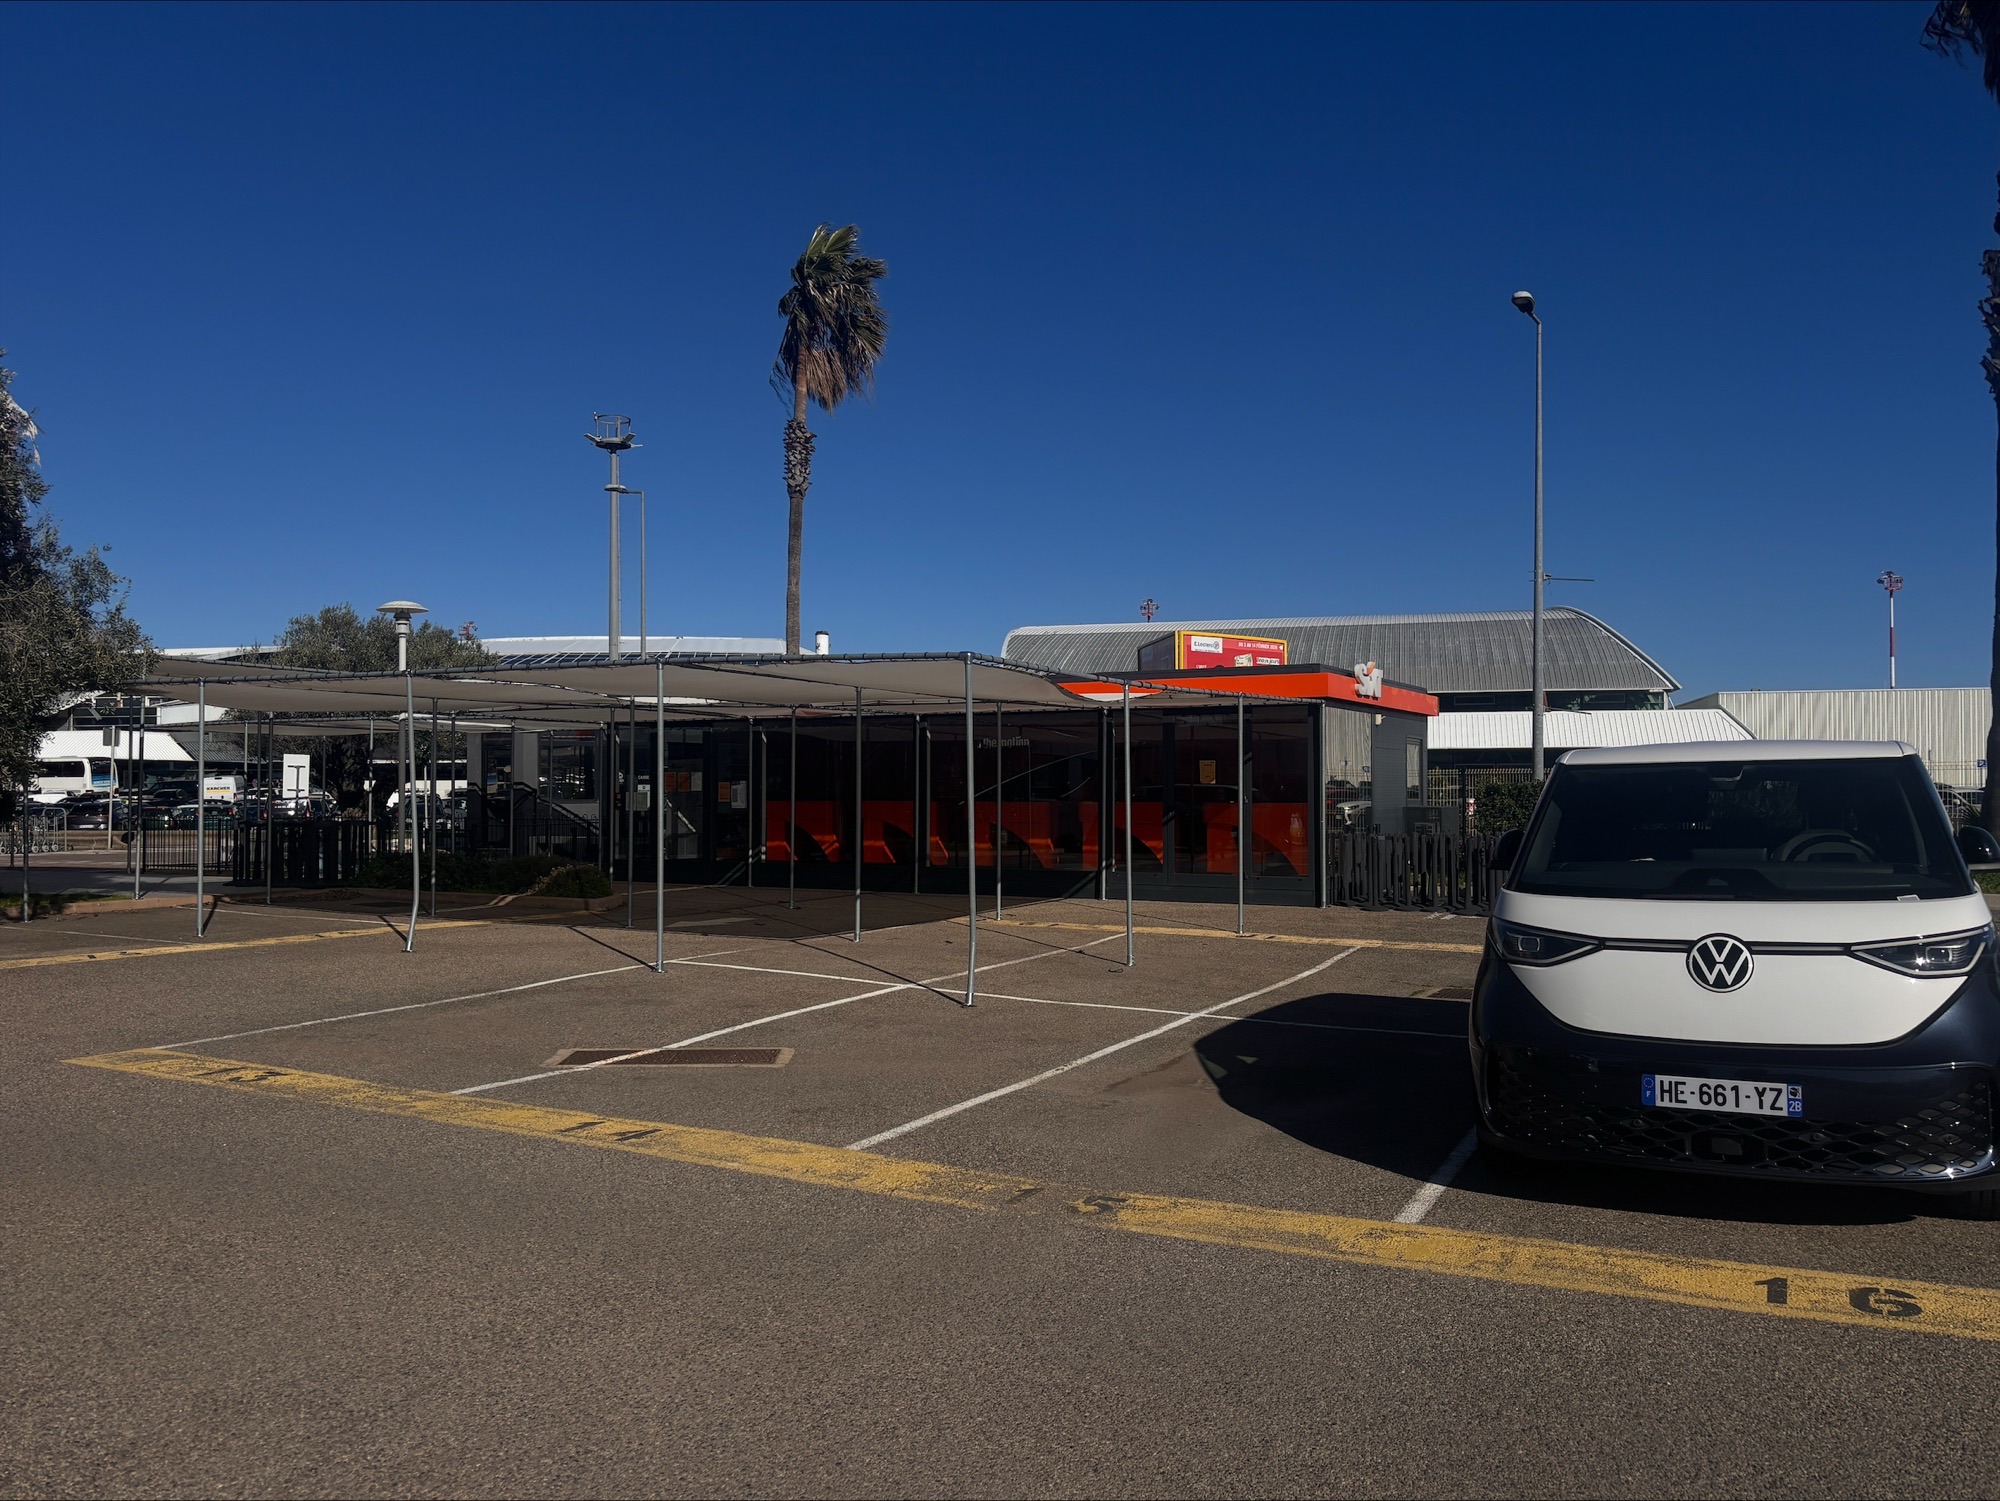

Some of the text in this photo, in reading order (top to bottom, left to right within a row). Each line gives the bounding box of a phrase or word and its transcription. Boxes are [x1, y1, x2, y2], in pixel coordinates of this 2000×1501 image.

[1660, 1080, 1784, 1111] HE-661-YZ
[1789, 1101, 1802, 1112] 2B
[1754, 1277, 1924, 1317] 16
